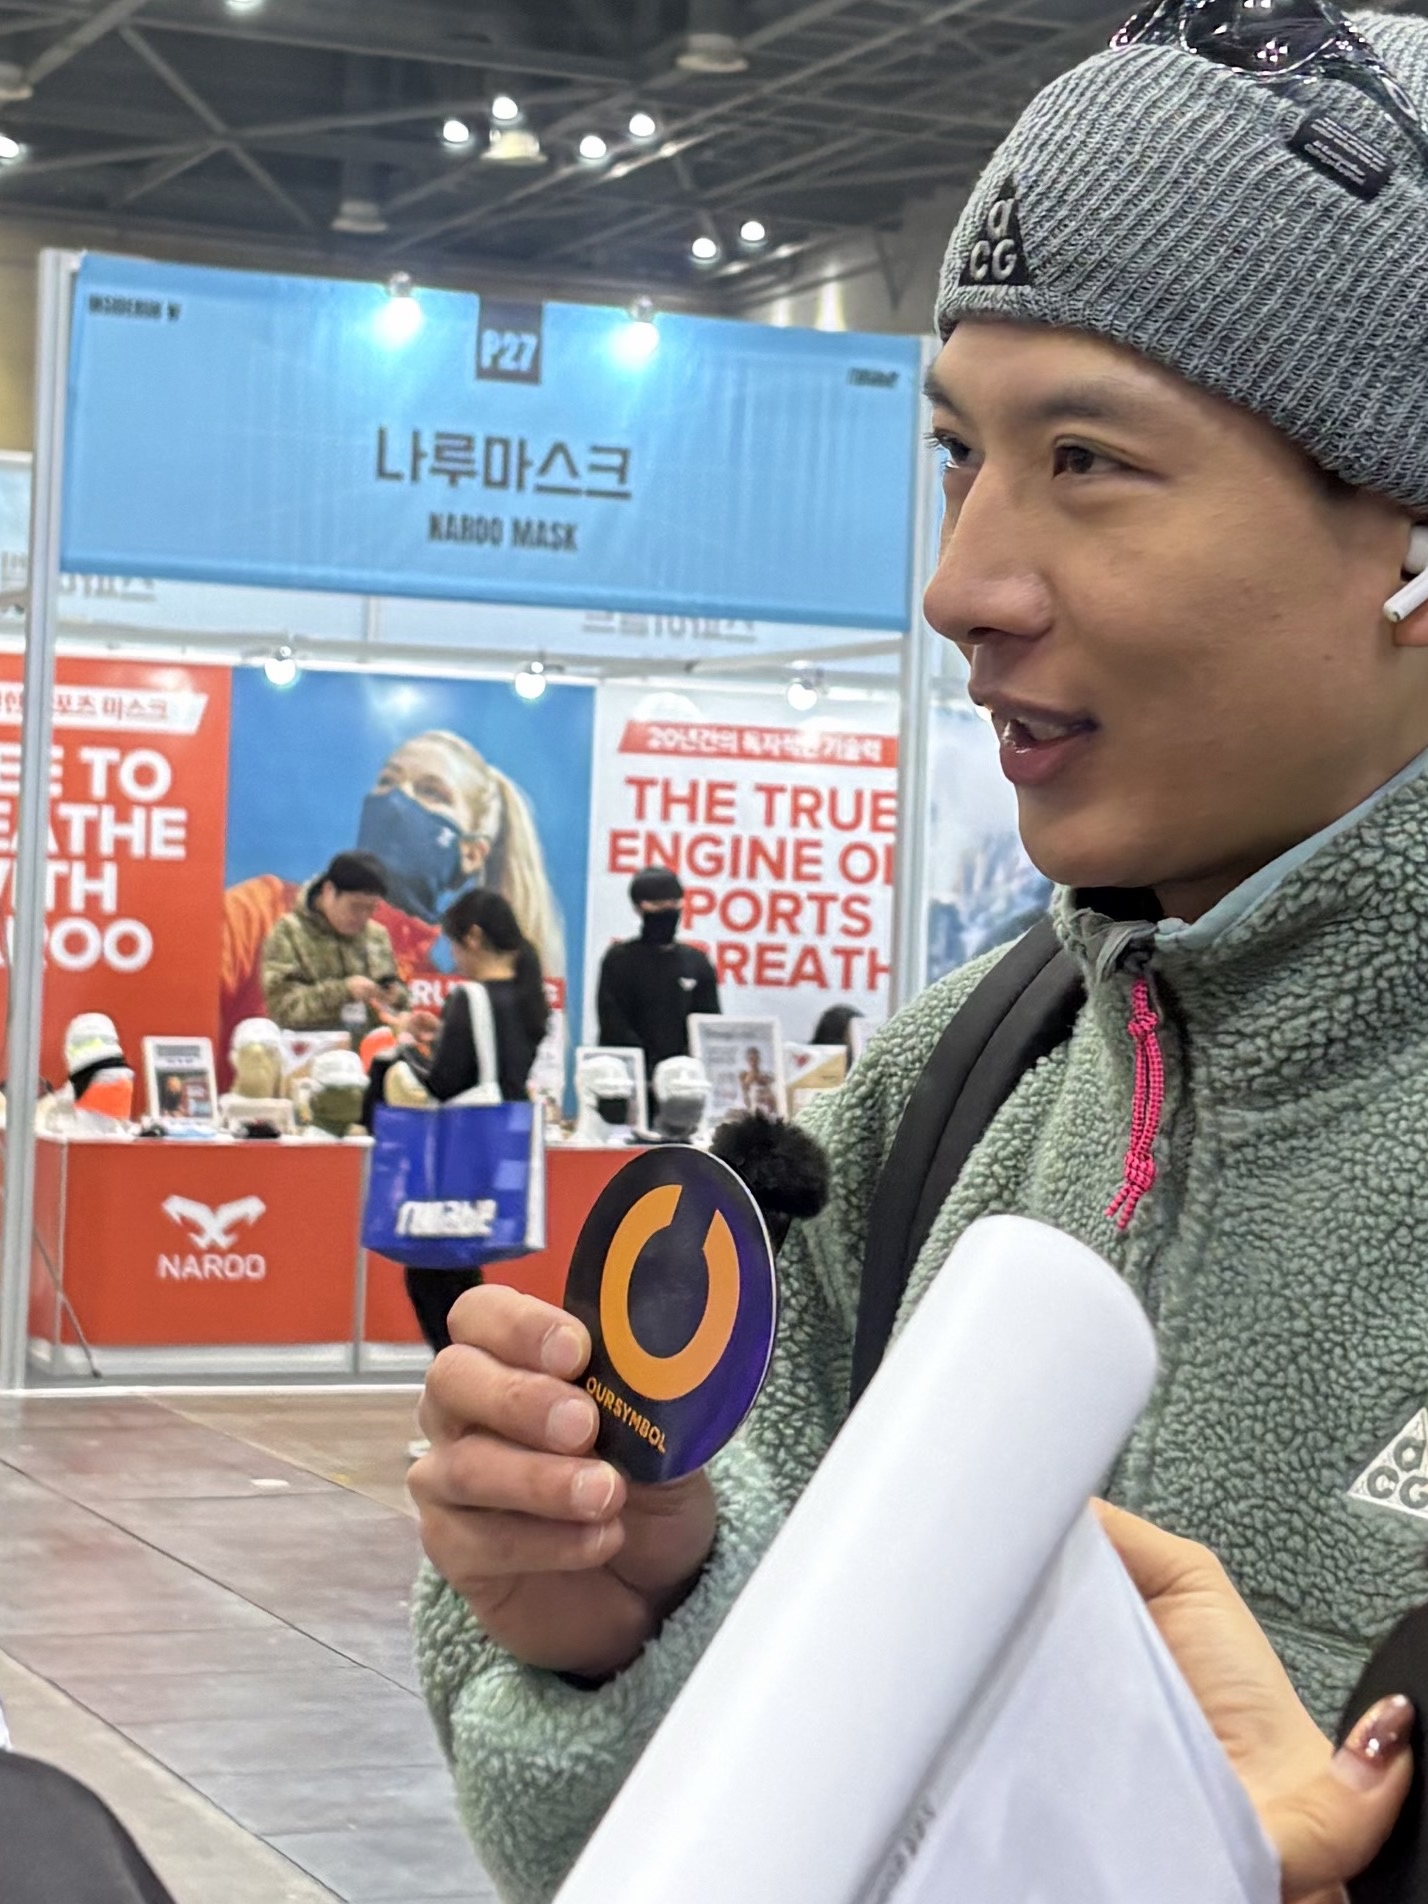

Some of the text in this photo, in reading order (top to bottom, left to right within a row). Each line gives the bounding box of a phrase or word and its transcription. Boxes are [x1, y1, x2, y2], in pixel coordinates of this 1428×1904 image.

[480, 328, 538, 373] P27
[376, 425, 632, 501] 나루마스크
[428, 511, 577, 553] NAROO MASK
[78, 746, 172, 803] TO
[625, 774, 896, 834] THE TRUE
[607, 828, 824, 884] ENGINE
[680, 884, 873, 939] PORTS
[156, 1253, 267, 1281] NAROO
[585, 1375, 667, 1455] OURSYMBOL
